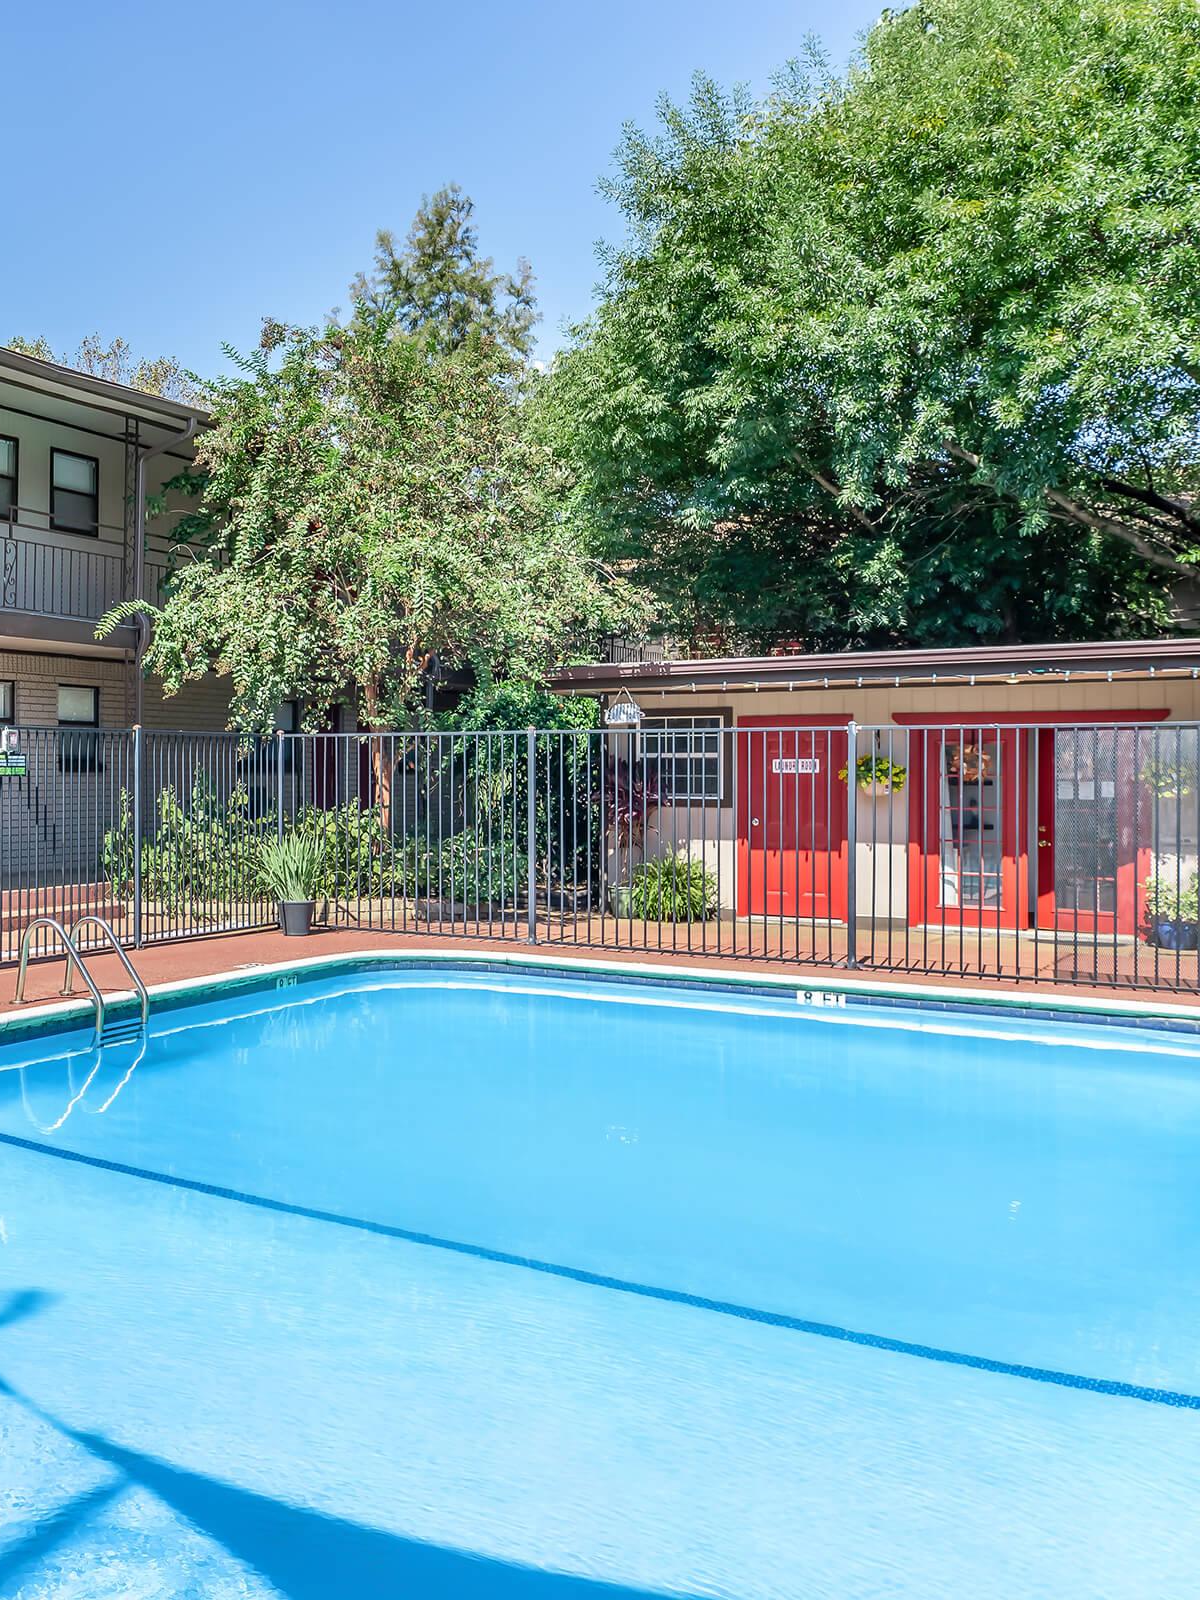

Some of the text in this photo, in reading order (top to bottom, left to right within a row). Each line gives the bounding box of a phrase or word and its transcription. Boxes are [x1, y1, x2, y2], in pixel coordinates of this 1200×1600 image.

[775, 761, 799, 771] LAUNDR
[804, 991, 843, 1004] 8 FT
